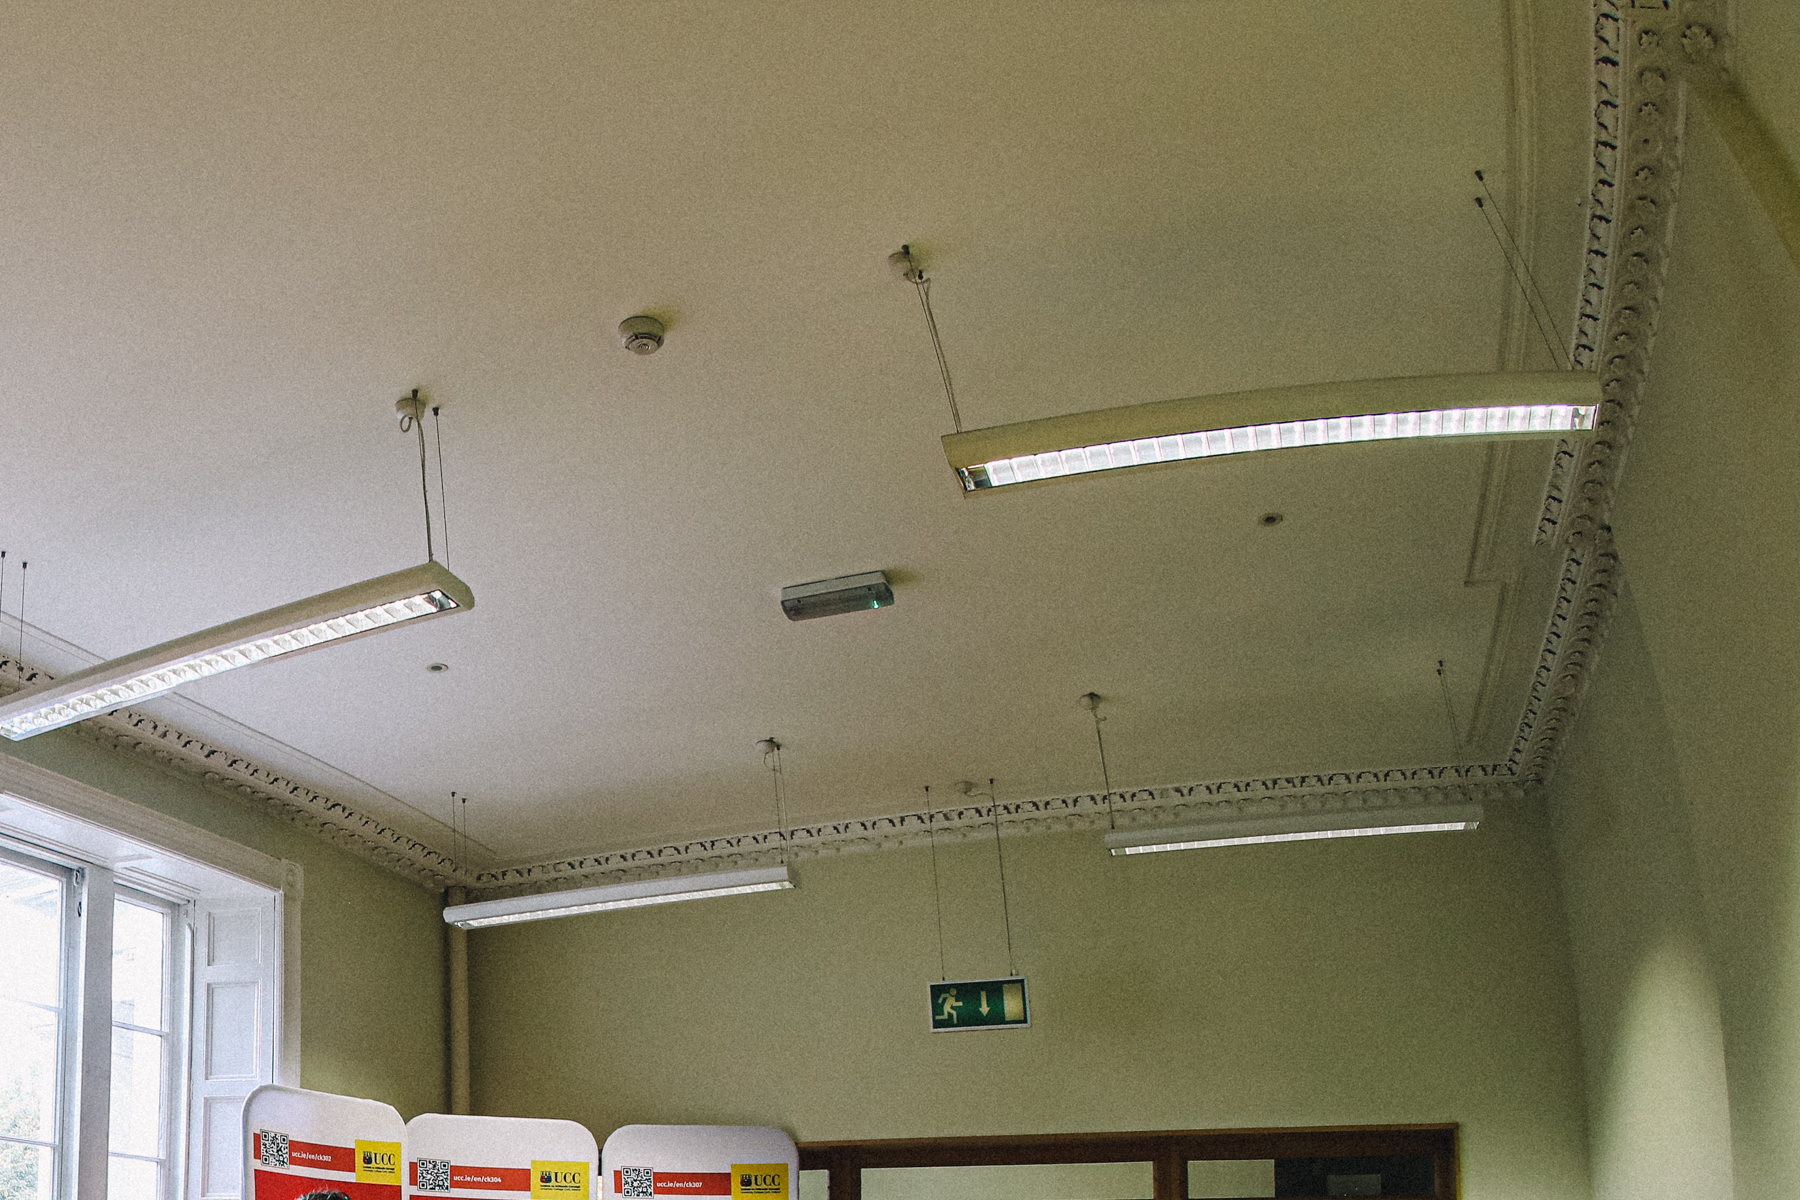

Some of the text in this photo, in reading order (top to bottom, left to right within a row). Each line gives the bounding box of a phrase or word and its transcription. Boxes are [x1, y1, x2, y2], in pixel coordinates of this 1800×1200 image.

[374, 1152, 396, 1166] UCC
[554, 1171, 581, 1184] UCC
[754, 1174, 781, 1187] UCC
[656, 1181, 703, 1189] ucc.ie/en/ck307
